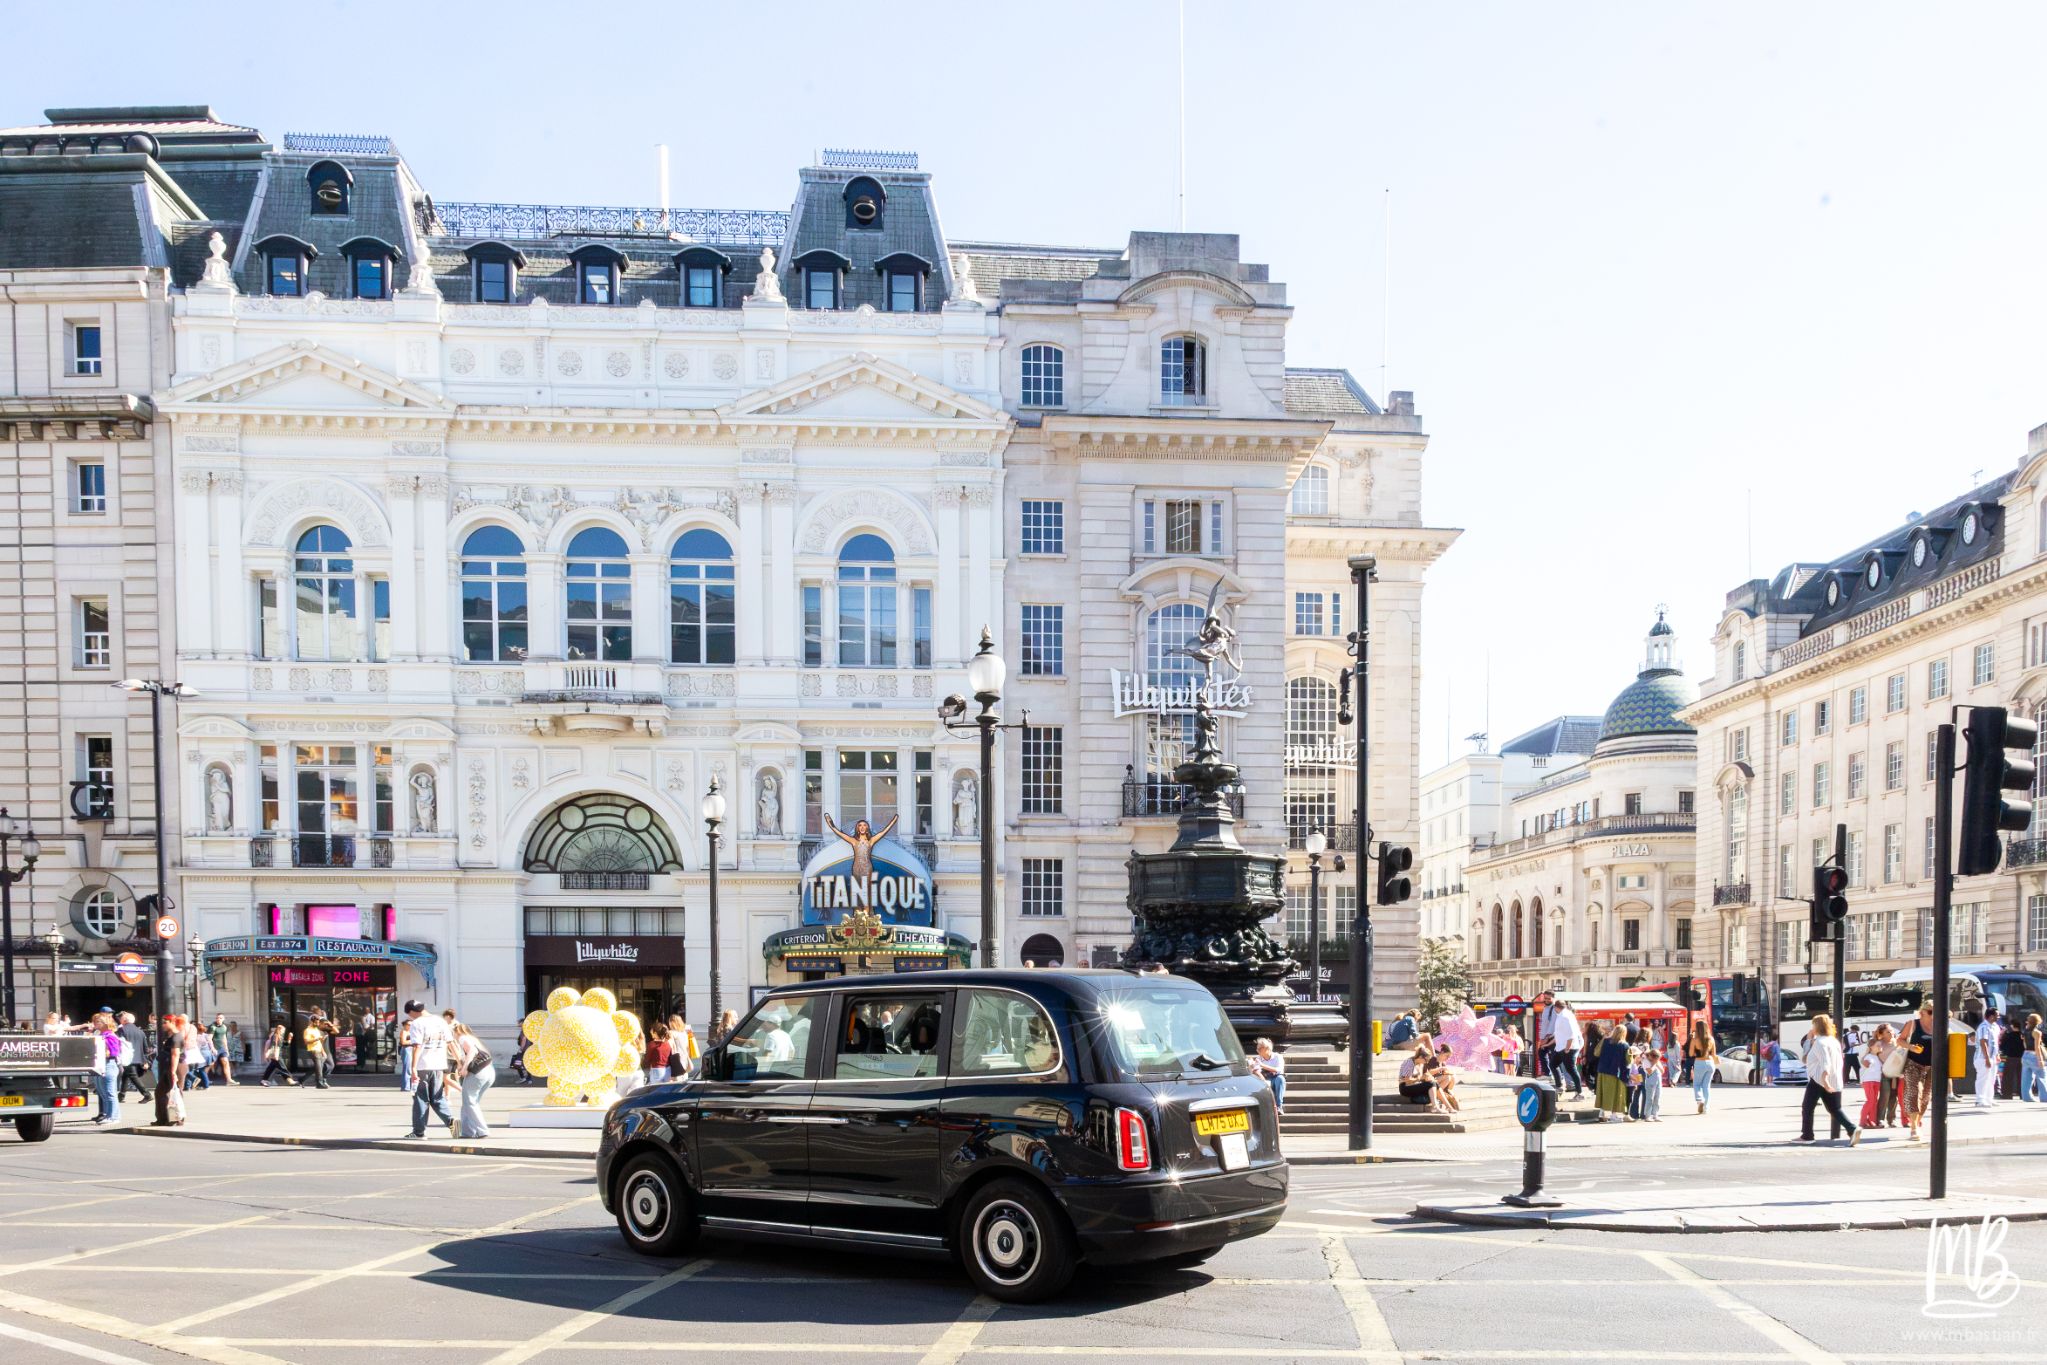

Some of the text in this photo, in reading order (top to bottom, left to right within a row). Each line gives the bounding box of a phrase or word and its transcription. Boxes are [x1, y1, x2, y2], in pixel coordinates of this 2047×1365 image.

[1285, 735, 1357, 770] ywhite
[1612, 843, 1650, 857] PLAZA
[161, 923, 175, 932] 20
[784, 932, 939, 945] CRITERION THEATRE
[317, 940, 381, 953] RESTAURANT
[575, 940, 639, 962] Lillywhites
[334, 971, 370, 982] ZONE
[0, 1042, 60, 1052] AMBERTI
